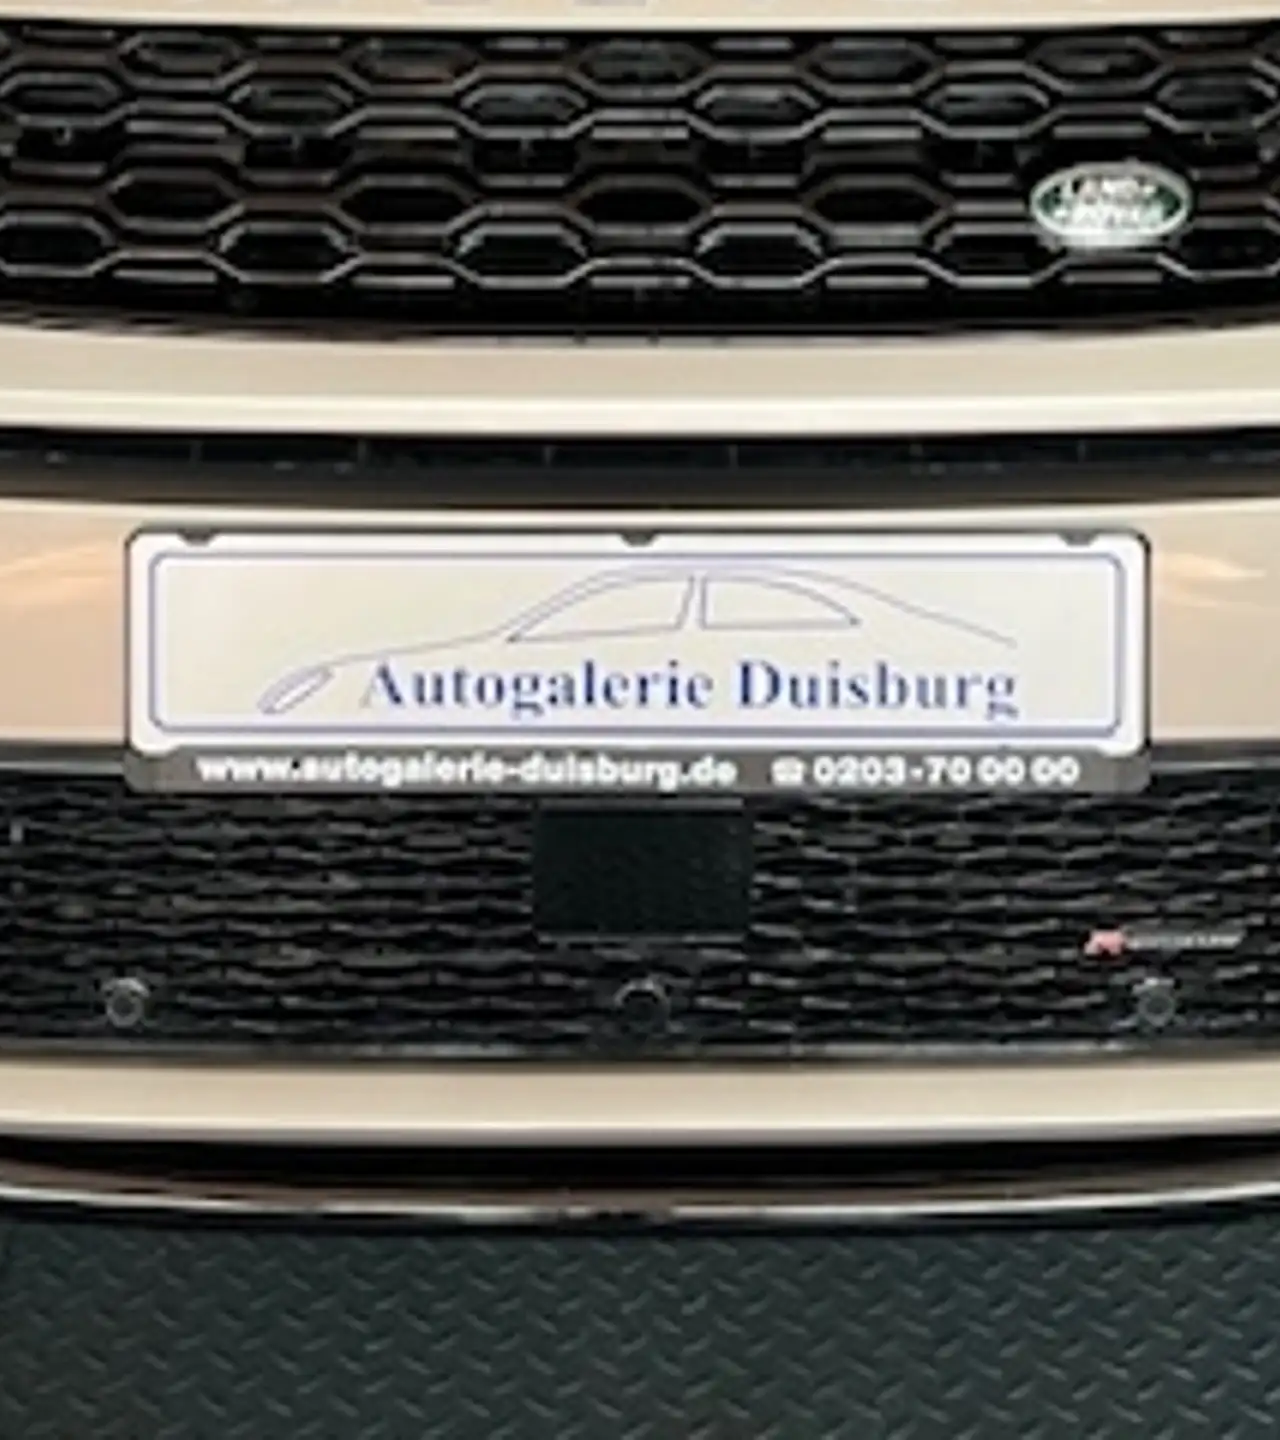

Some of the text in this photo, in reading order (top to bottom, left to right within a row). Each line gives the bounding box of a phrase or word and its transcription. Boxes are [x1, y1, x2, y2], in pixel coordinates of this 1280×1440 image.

[358, 659, 1020, 721] Autogalerie Duisburg
[194, 751, 738, 790] www.autogalerie-duisburg.de
[976, 754, 1025, 788] 00
[1030, 754, 1082, 788] 00
